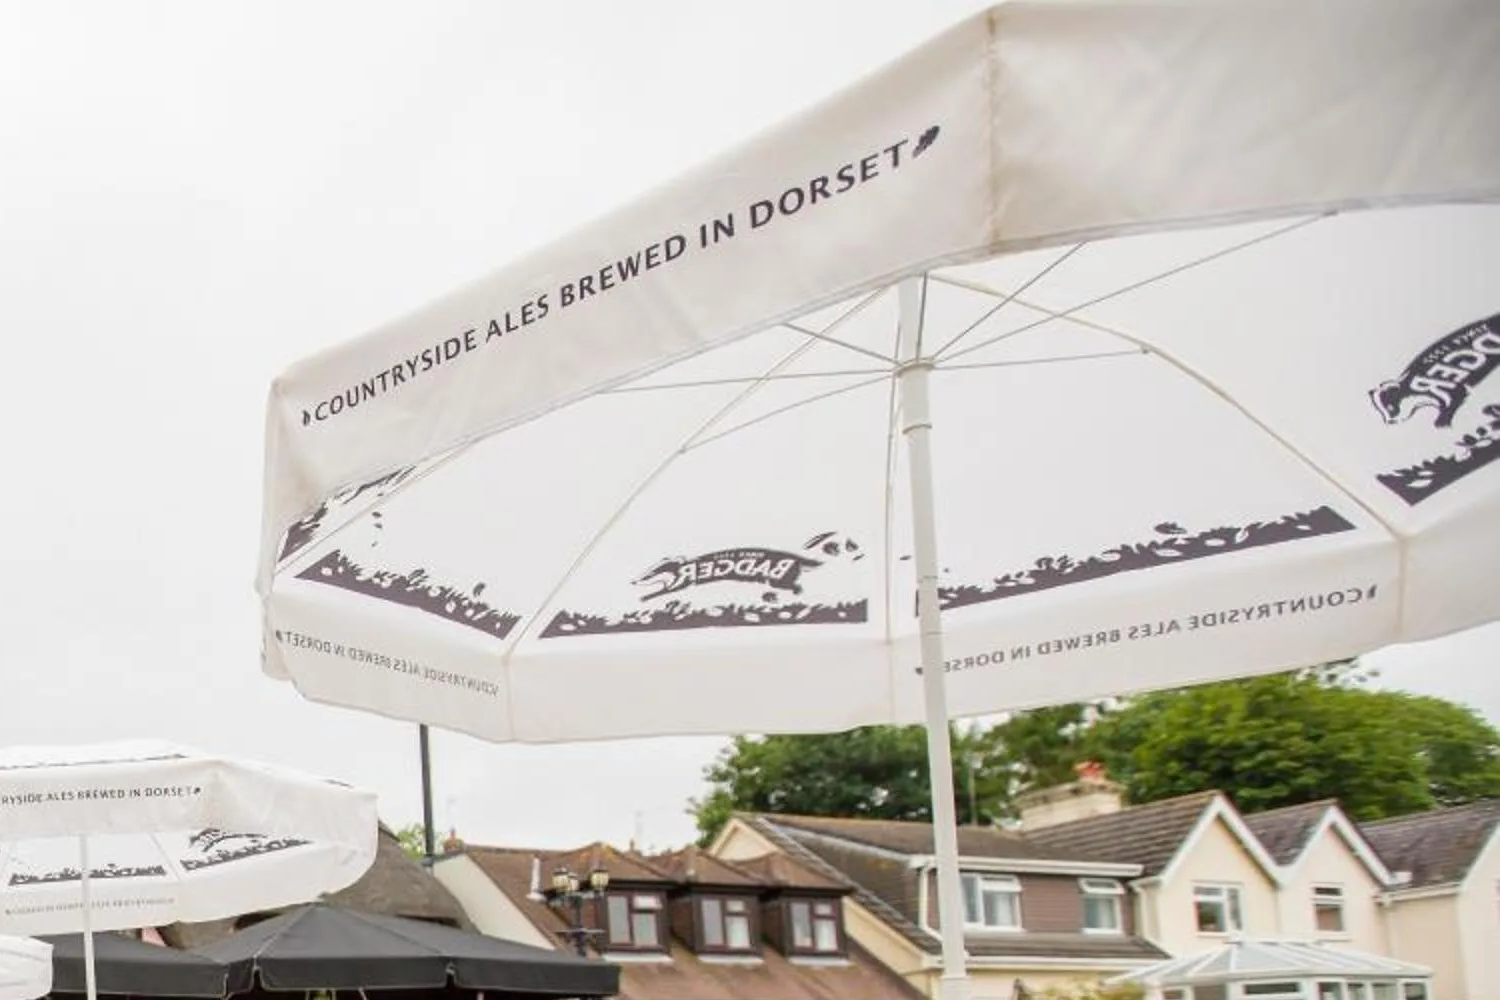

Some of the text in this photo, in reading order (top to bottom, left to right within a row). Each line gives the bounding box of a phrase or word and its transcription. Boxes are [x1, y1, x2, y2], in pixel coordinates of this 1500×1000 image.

[315, 139, 909, 421] COUNTRYSIDE ALES BREWED IN DORSET
